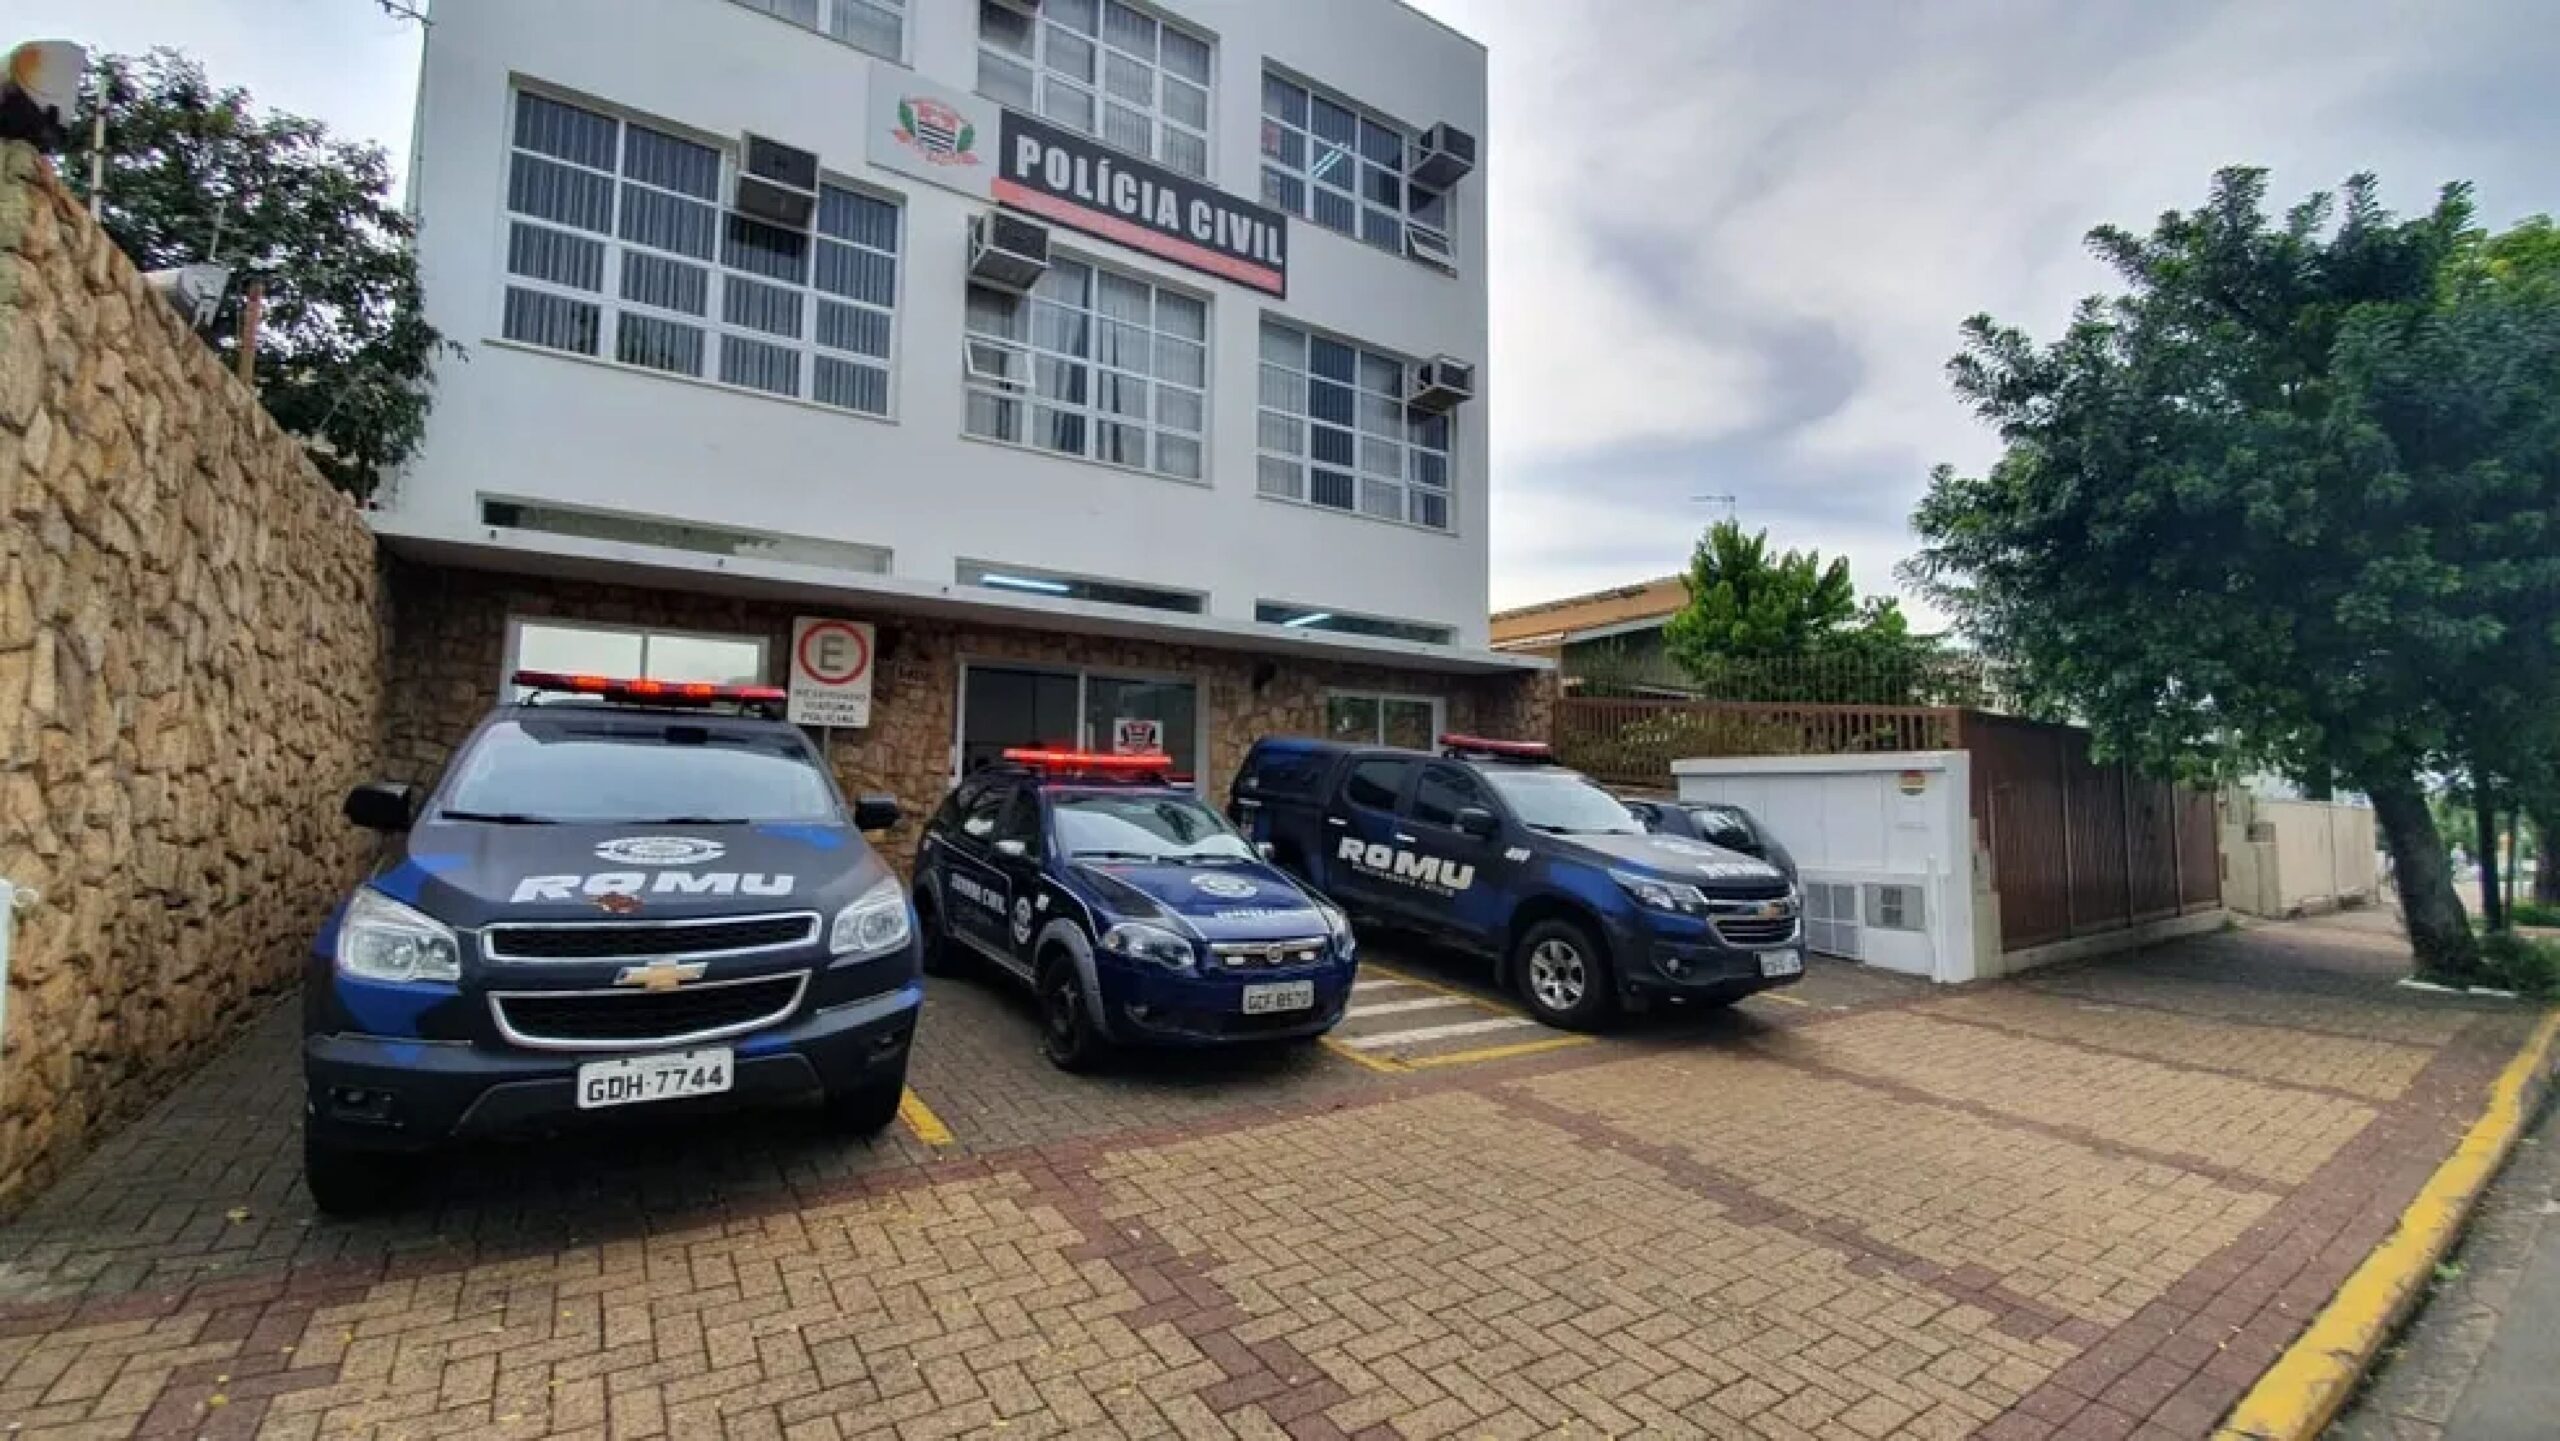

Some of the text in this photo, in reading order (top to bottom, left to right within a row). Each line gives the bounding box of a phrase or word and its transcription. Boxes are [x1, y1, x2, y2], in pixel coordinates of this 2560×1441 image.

[1016, 133, 1283, 264] POLÍCIA CIVIL
[819, 635, 844, 671] E
[1338, 836, 1475, 889] ROMU
[509, 871, 796, 903] ROMU
